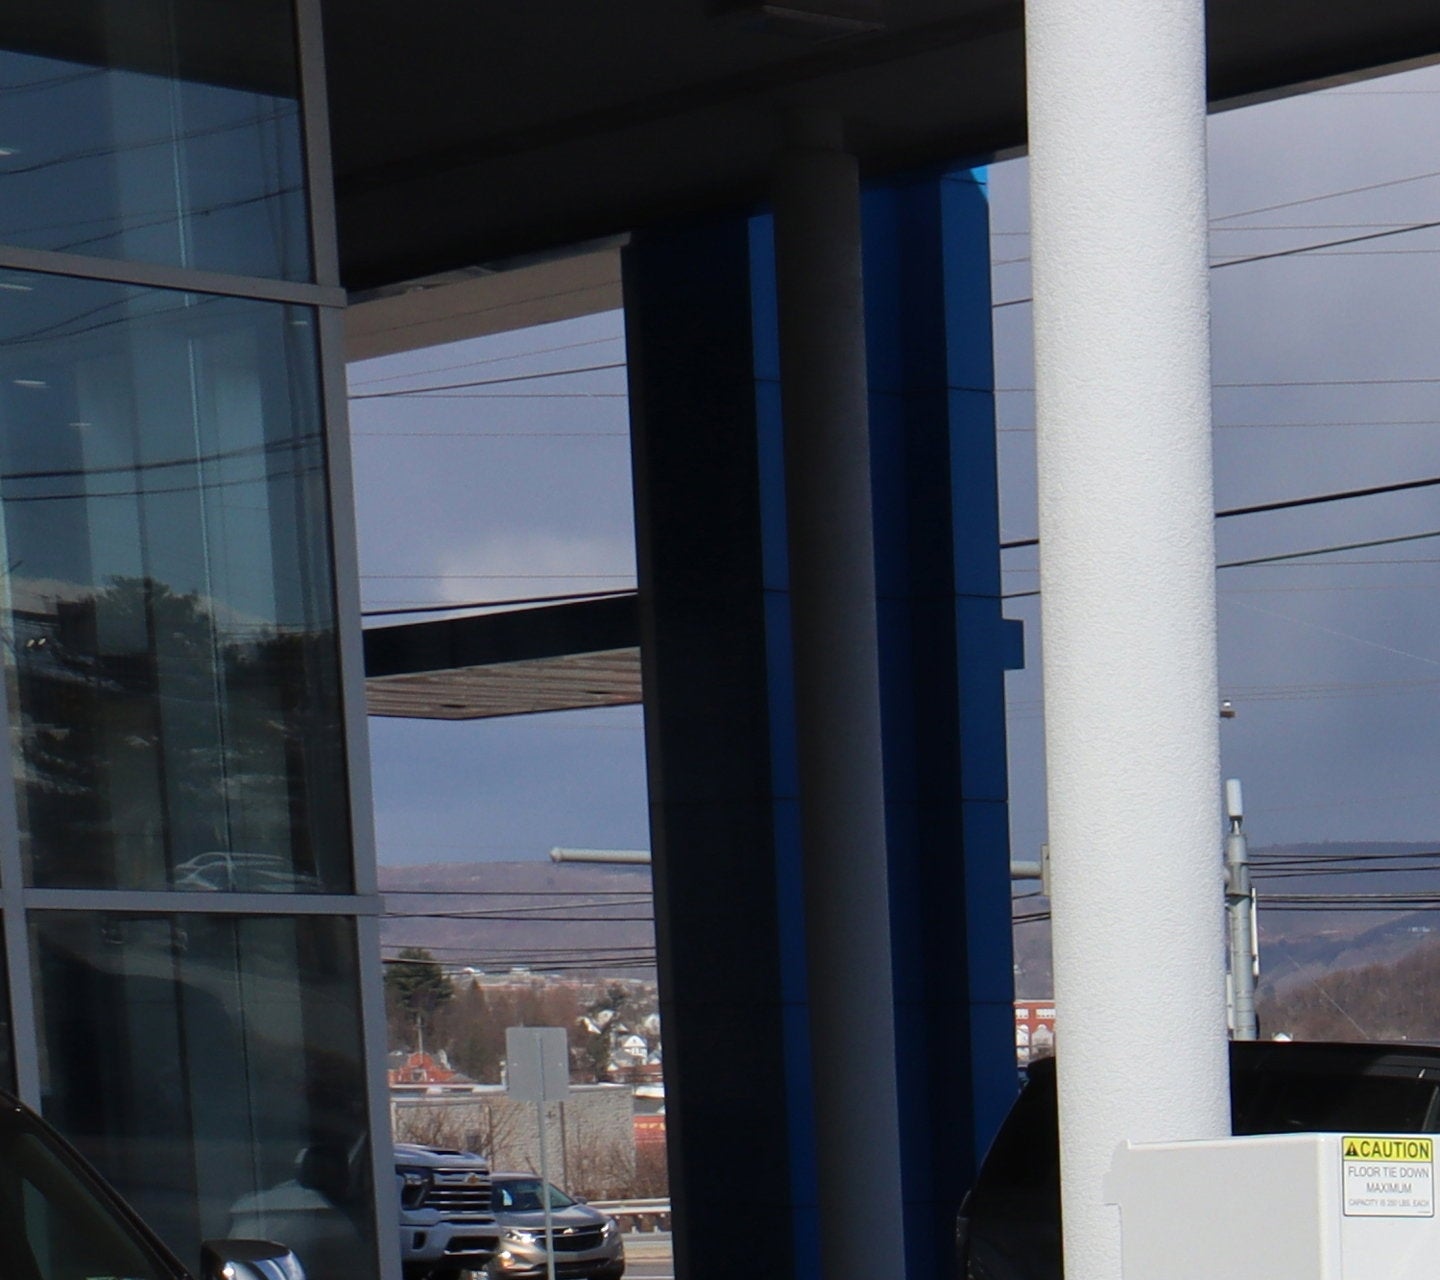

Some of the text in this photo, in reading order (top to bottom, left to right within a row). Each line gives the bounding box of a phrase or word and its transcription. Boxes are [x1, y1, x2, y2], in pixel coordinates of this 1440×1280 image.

[1360, 1140, 1430, 1159] CAUTION
[1348, 1166, 1430, 1178] FLOOR TIE DOWN
[1366, 1182, 1413, 1193] MAXIMUM
